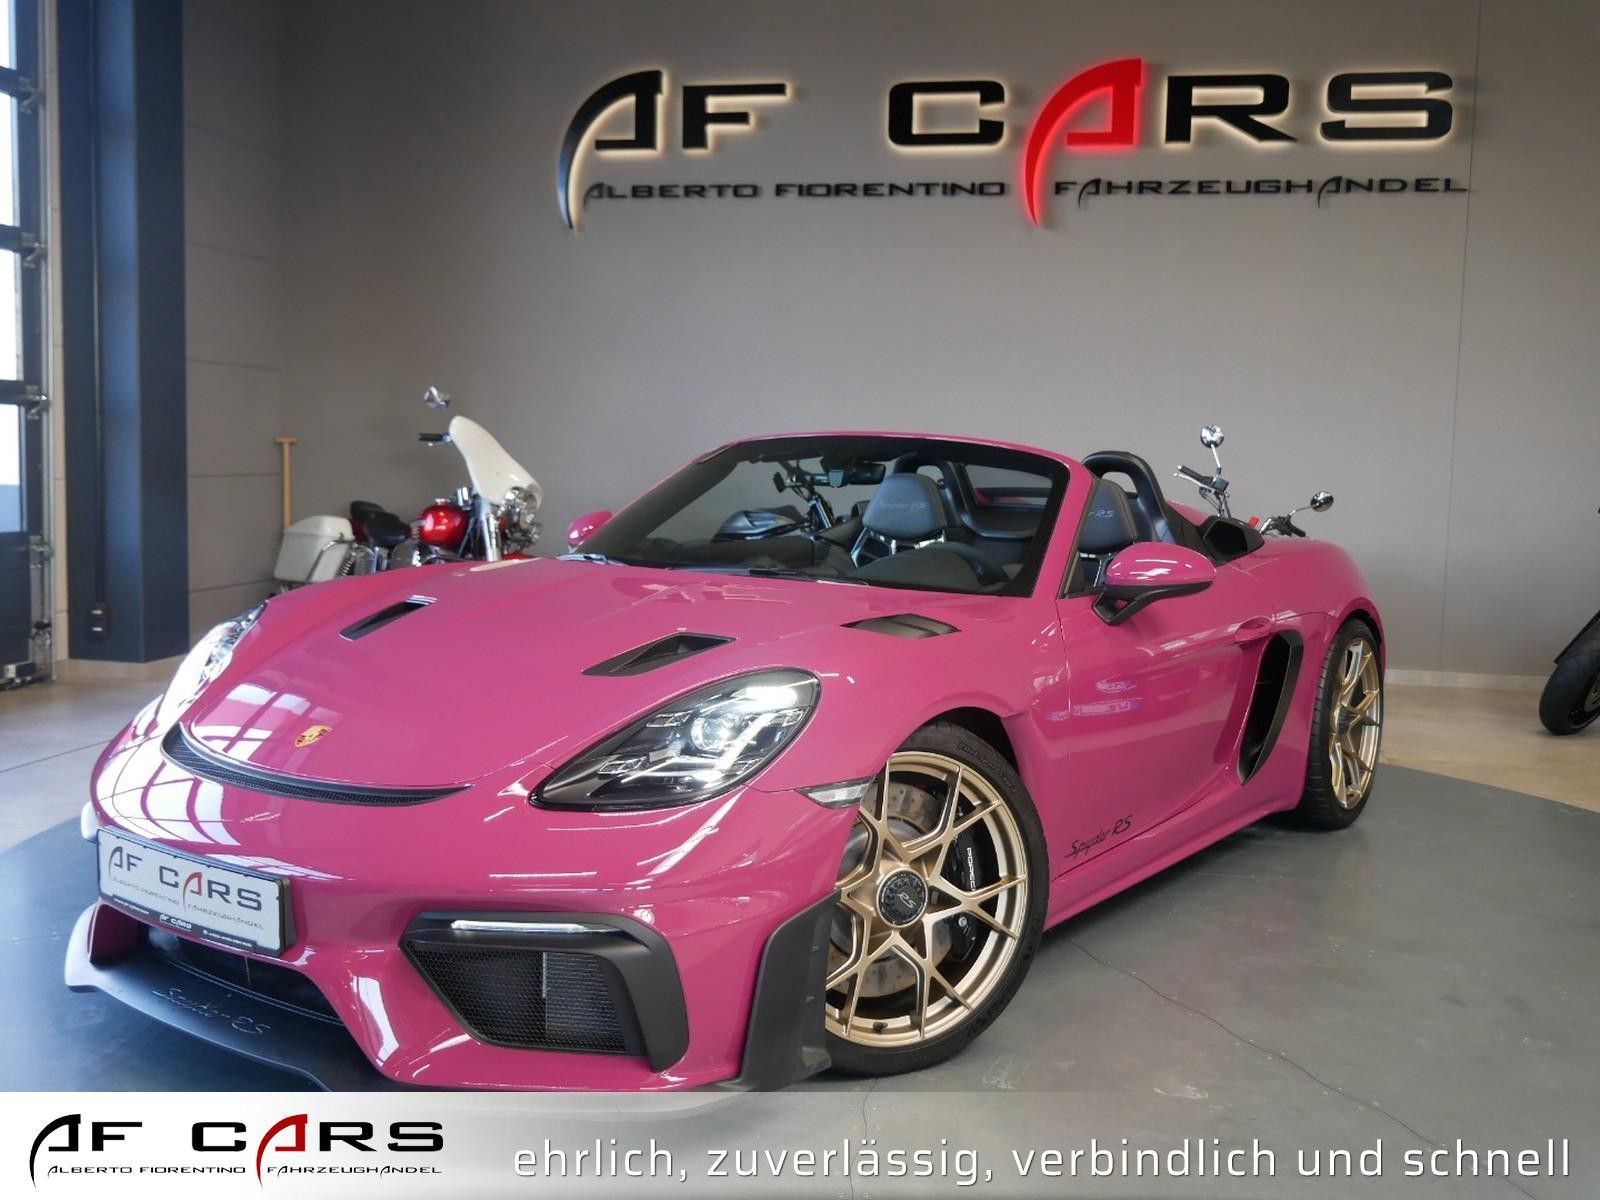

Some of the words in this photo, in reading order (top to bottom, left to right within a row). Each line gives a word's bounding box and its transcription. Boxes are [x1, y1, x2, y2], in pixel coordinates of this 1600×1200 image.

[558, 69, 787, 229] AF
[888, 58, 1453, 227] CARS
[583, 182, 759, 209] ALBERTO
[774, 181, 1006, 199] FIORENTINO
[1054, 175, 1468, 209] FAHRZEUGHANDEL
[1064, 828, 1111, 858] Spyder
[1111, 814, 1134, 836] RS
[108, 846, 143, 881] AF
[159, 865, 263, 915] CARS
